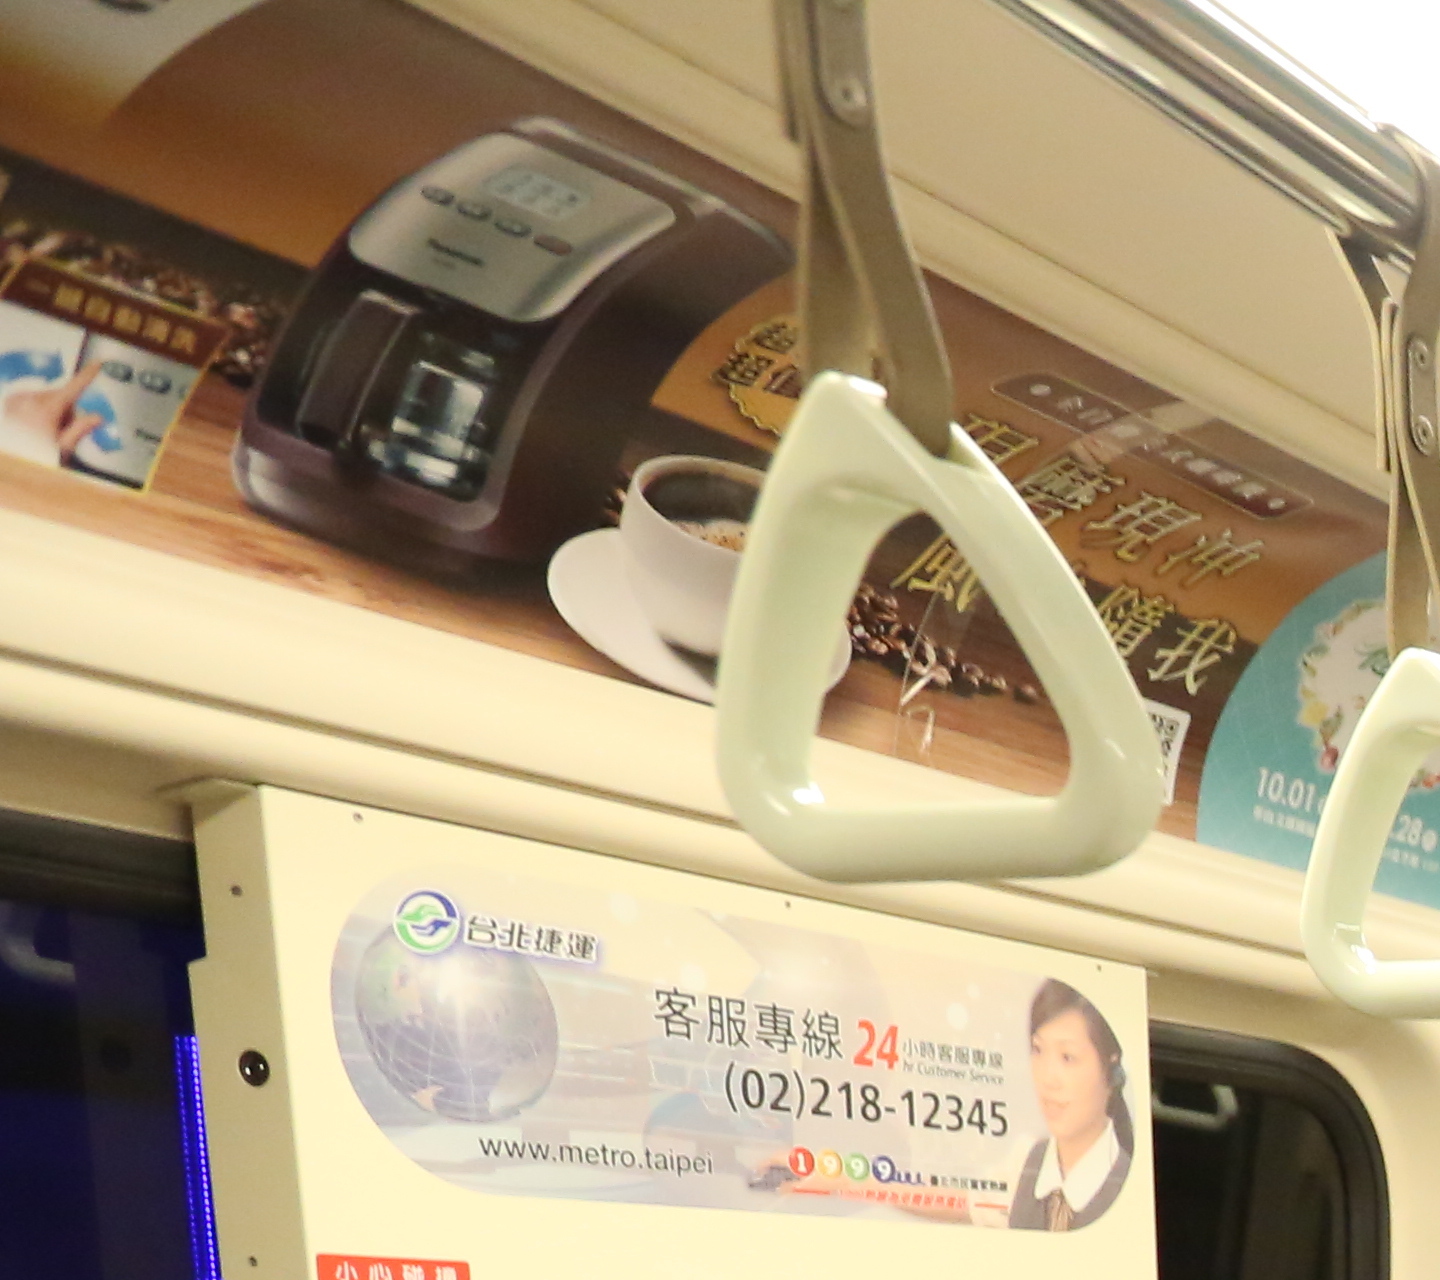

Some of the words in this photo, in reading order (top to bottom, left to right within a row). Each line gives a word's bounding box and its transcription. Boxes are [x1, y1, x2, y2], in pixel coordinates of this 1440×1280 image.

[1257, 766, 1316, 813] 10.01
[467, 914, 597, 960] 台北捷運
[653, 986, 844, 1061] 客服專線
[853, 1018, 900, 1070] 24
[917, 1062, 967, 1081] Customer
[969, 1070, 1004, 1087] Service
[724, 1061, 1009, 1137] (02)218-12345
[479, 1137, 714, 1177] www.metro.taipei
[789, 1146, 895, 1183] 1999
